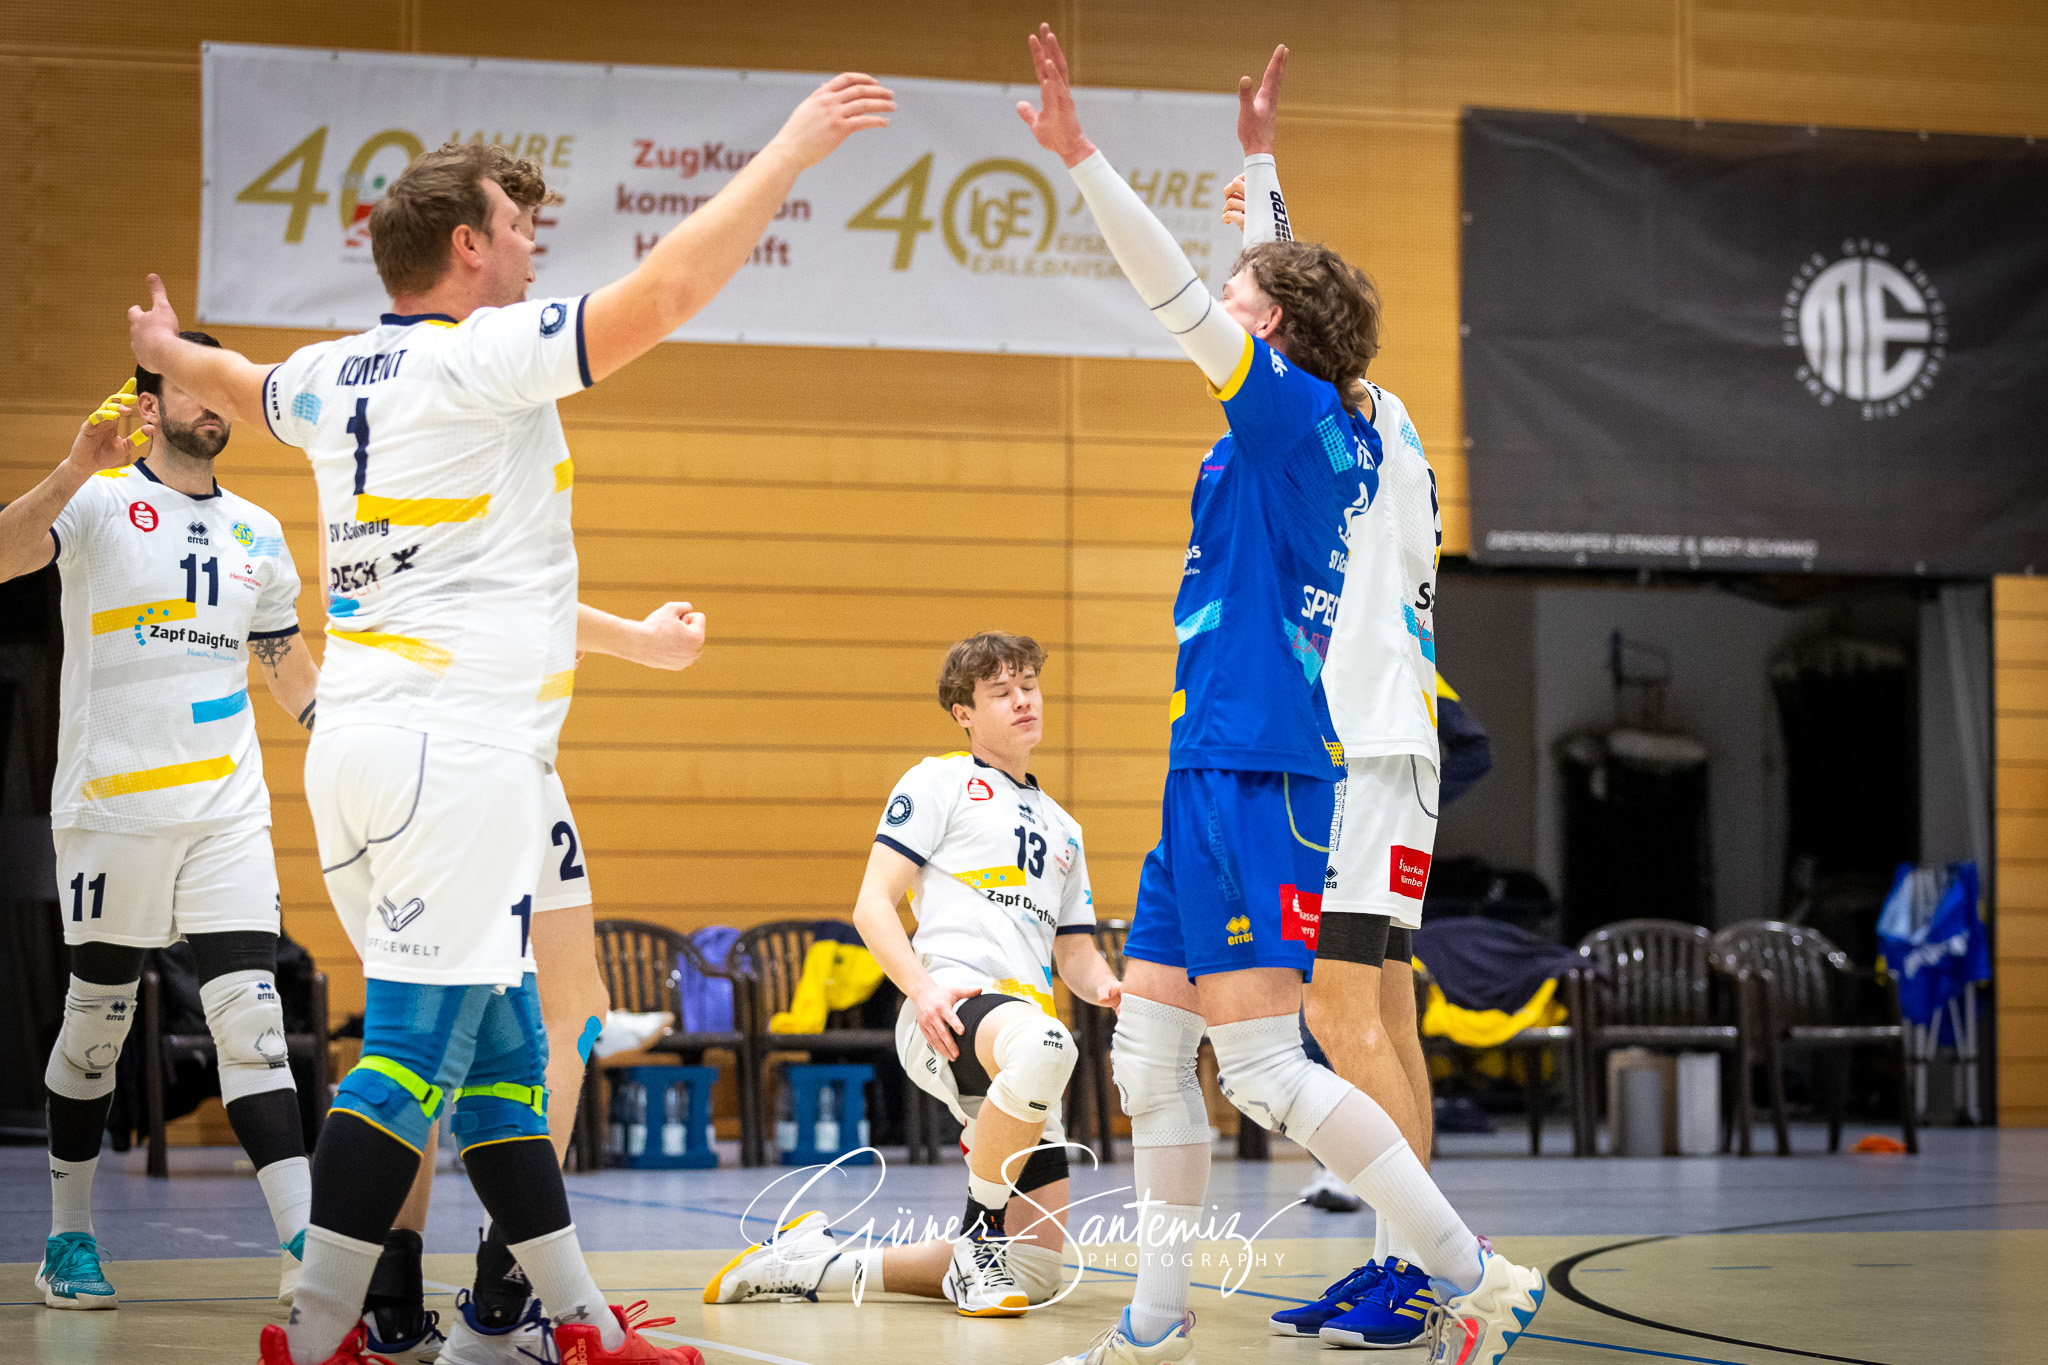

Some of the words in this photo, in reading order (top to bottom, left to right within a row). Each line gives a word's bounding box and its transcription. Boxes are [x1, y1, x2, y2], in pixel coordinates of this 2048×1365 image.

[633, 138, 758, 179] ZugKu
[346, 398, 370, 496] 1
[187, 535, 210, 546] errea
[329, 523, 341, 542] SV
[180, 553, 218, 607] 11
[150, 625, 186, 642] Zapf
[551, 820, 585, 882] 2
[1014, 825, 1048, 879] 13
[70, 872, 106, 922] 11
[986, 889, 1020, 907] Zapf
[511, 894, 532, 958] 1
[1043, 1039, 1063, 1050] errea
